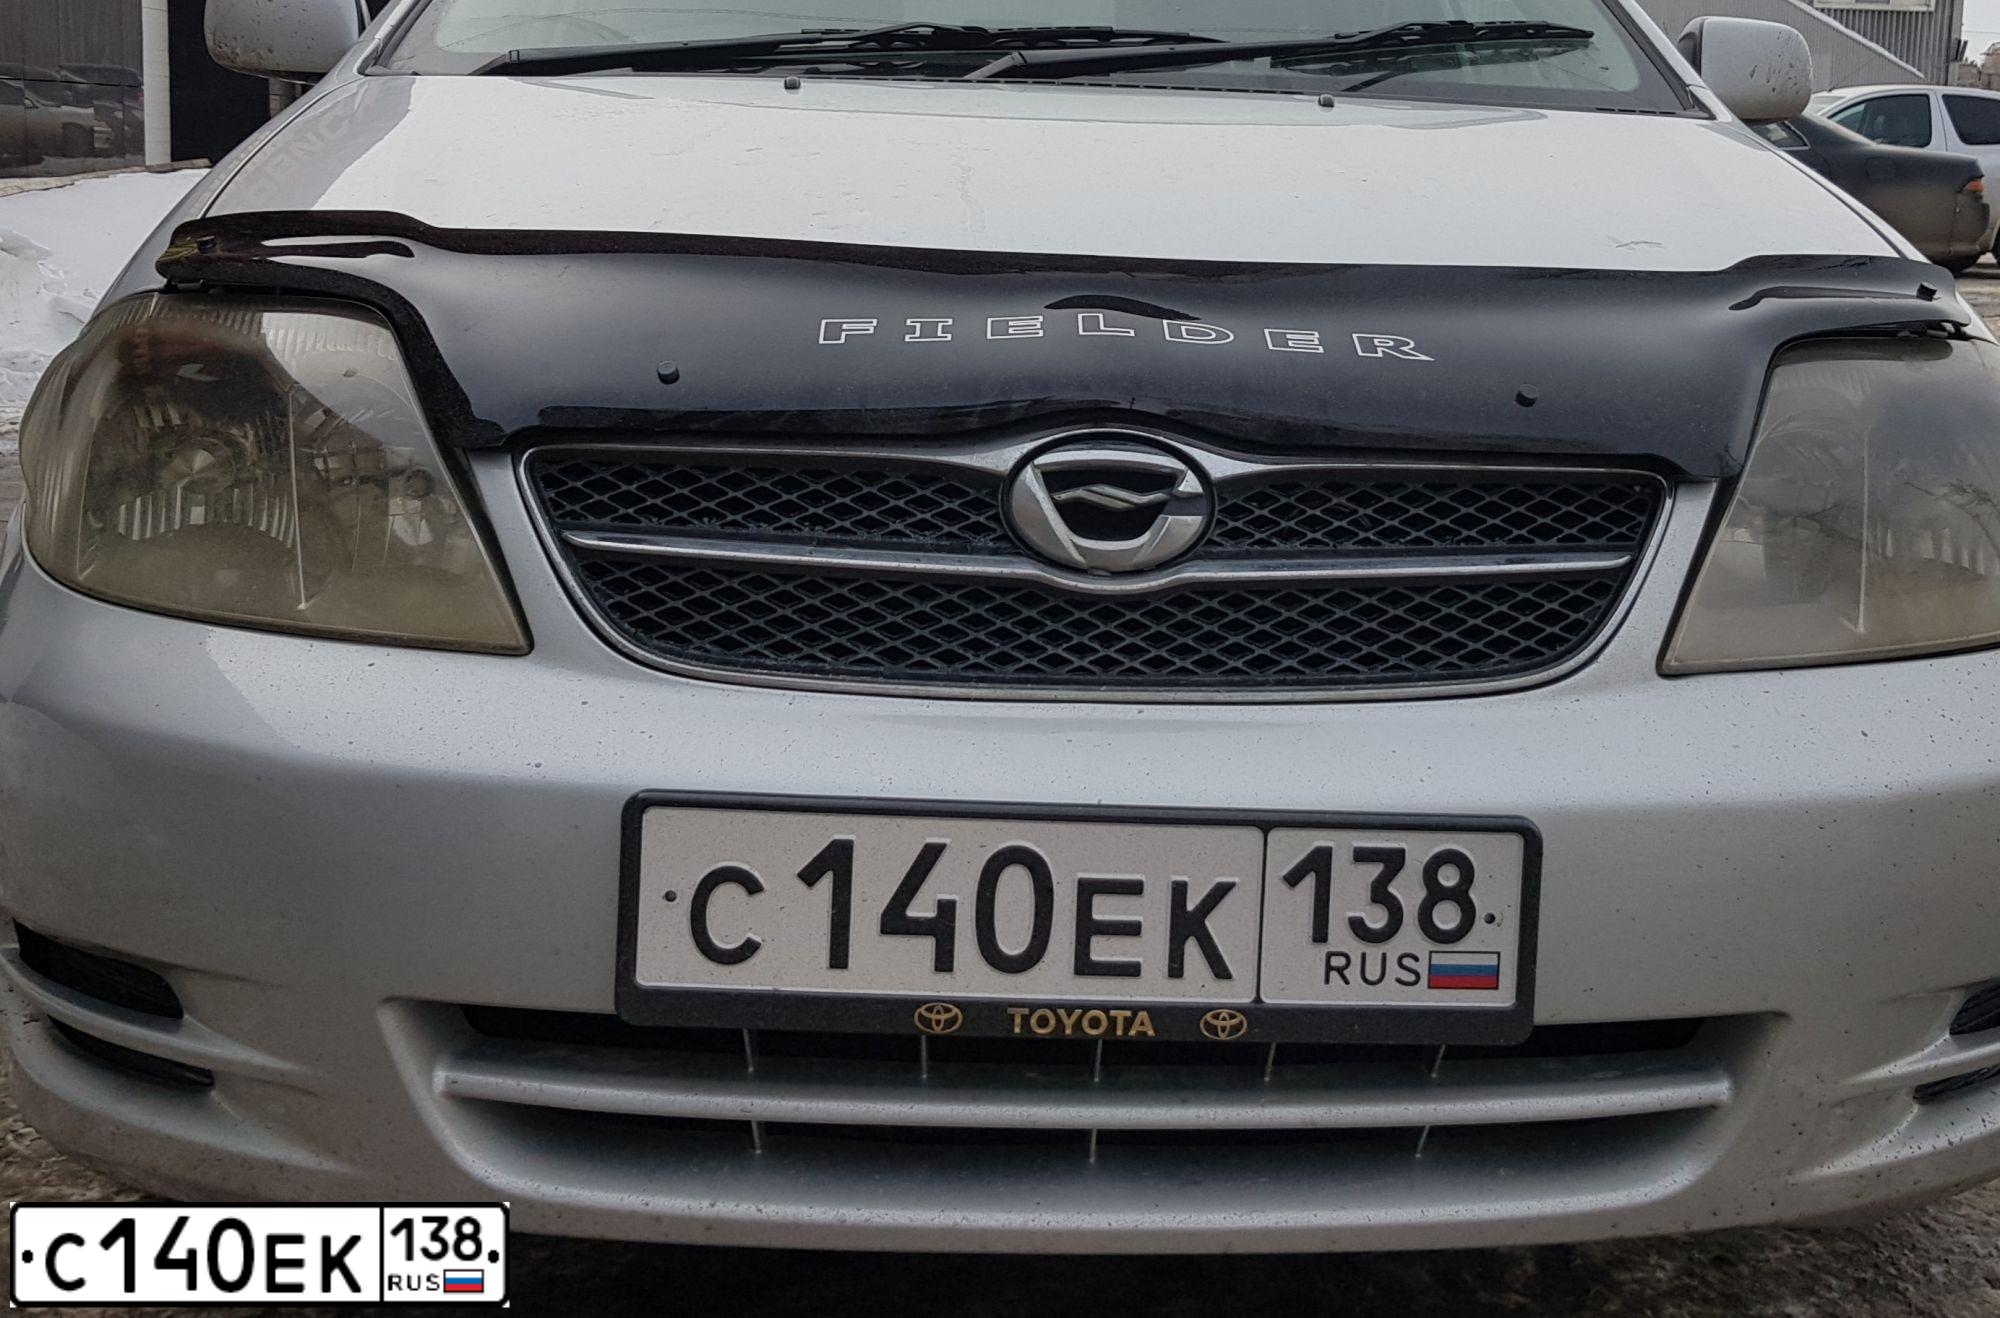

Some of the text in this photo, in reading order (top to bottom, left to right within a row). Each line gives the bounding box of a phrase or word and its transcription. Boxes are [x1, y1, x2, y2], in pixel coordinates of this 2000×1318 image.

[817, 311, 1436, 361] FIELDER
[689, 836, 1477, 980] C140EK 138
[1323, 950, 1422, 987] RUS
[1006, 1006, 1156, 1038] TOYOTA
